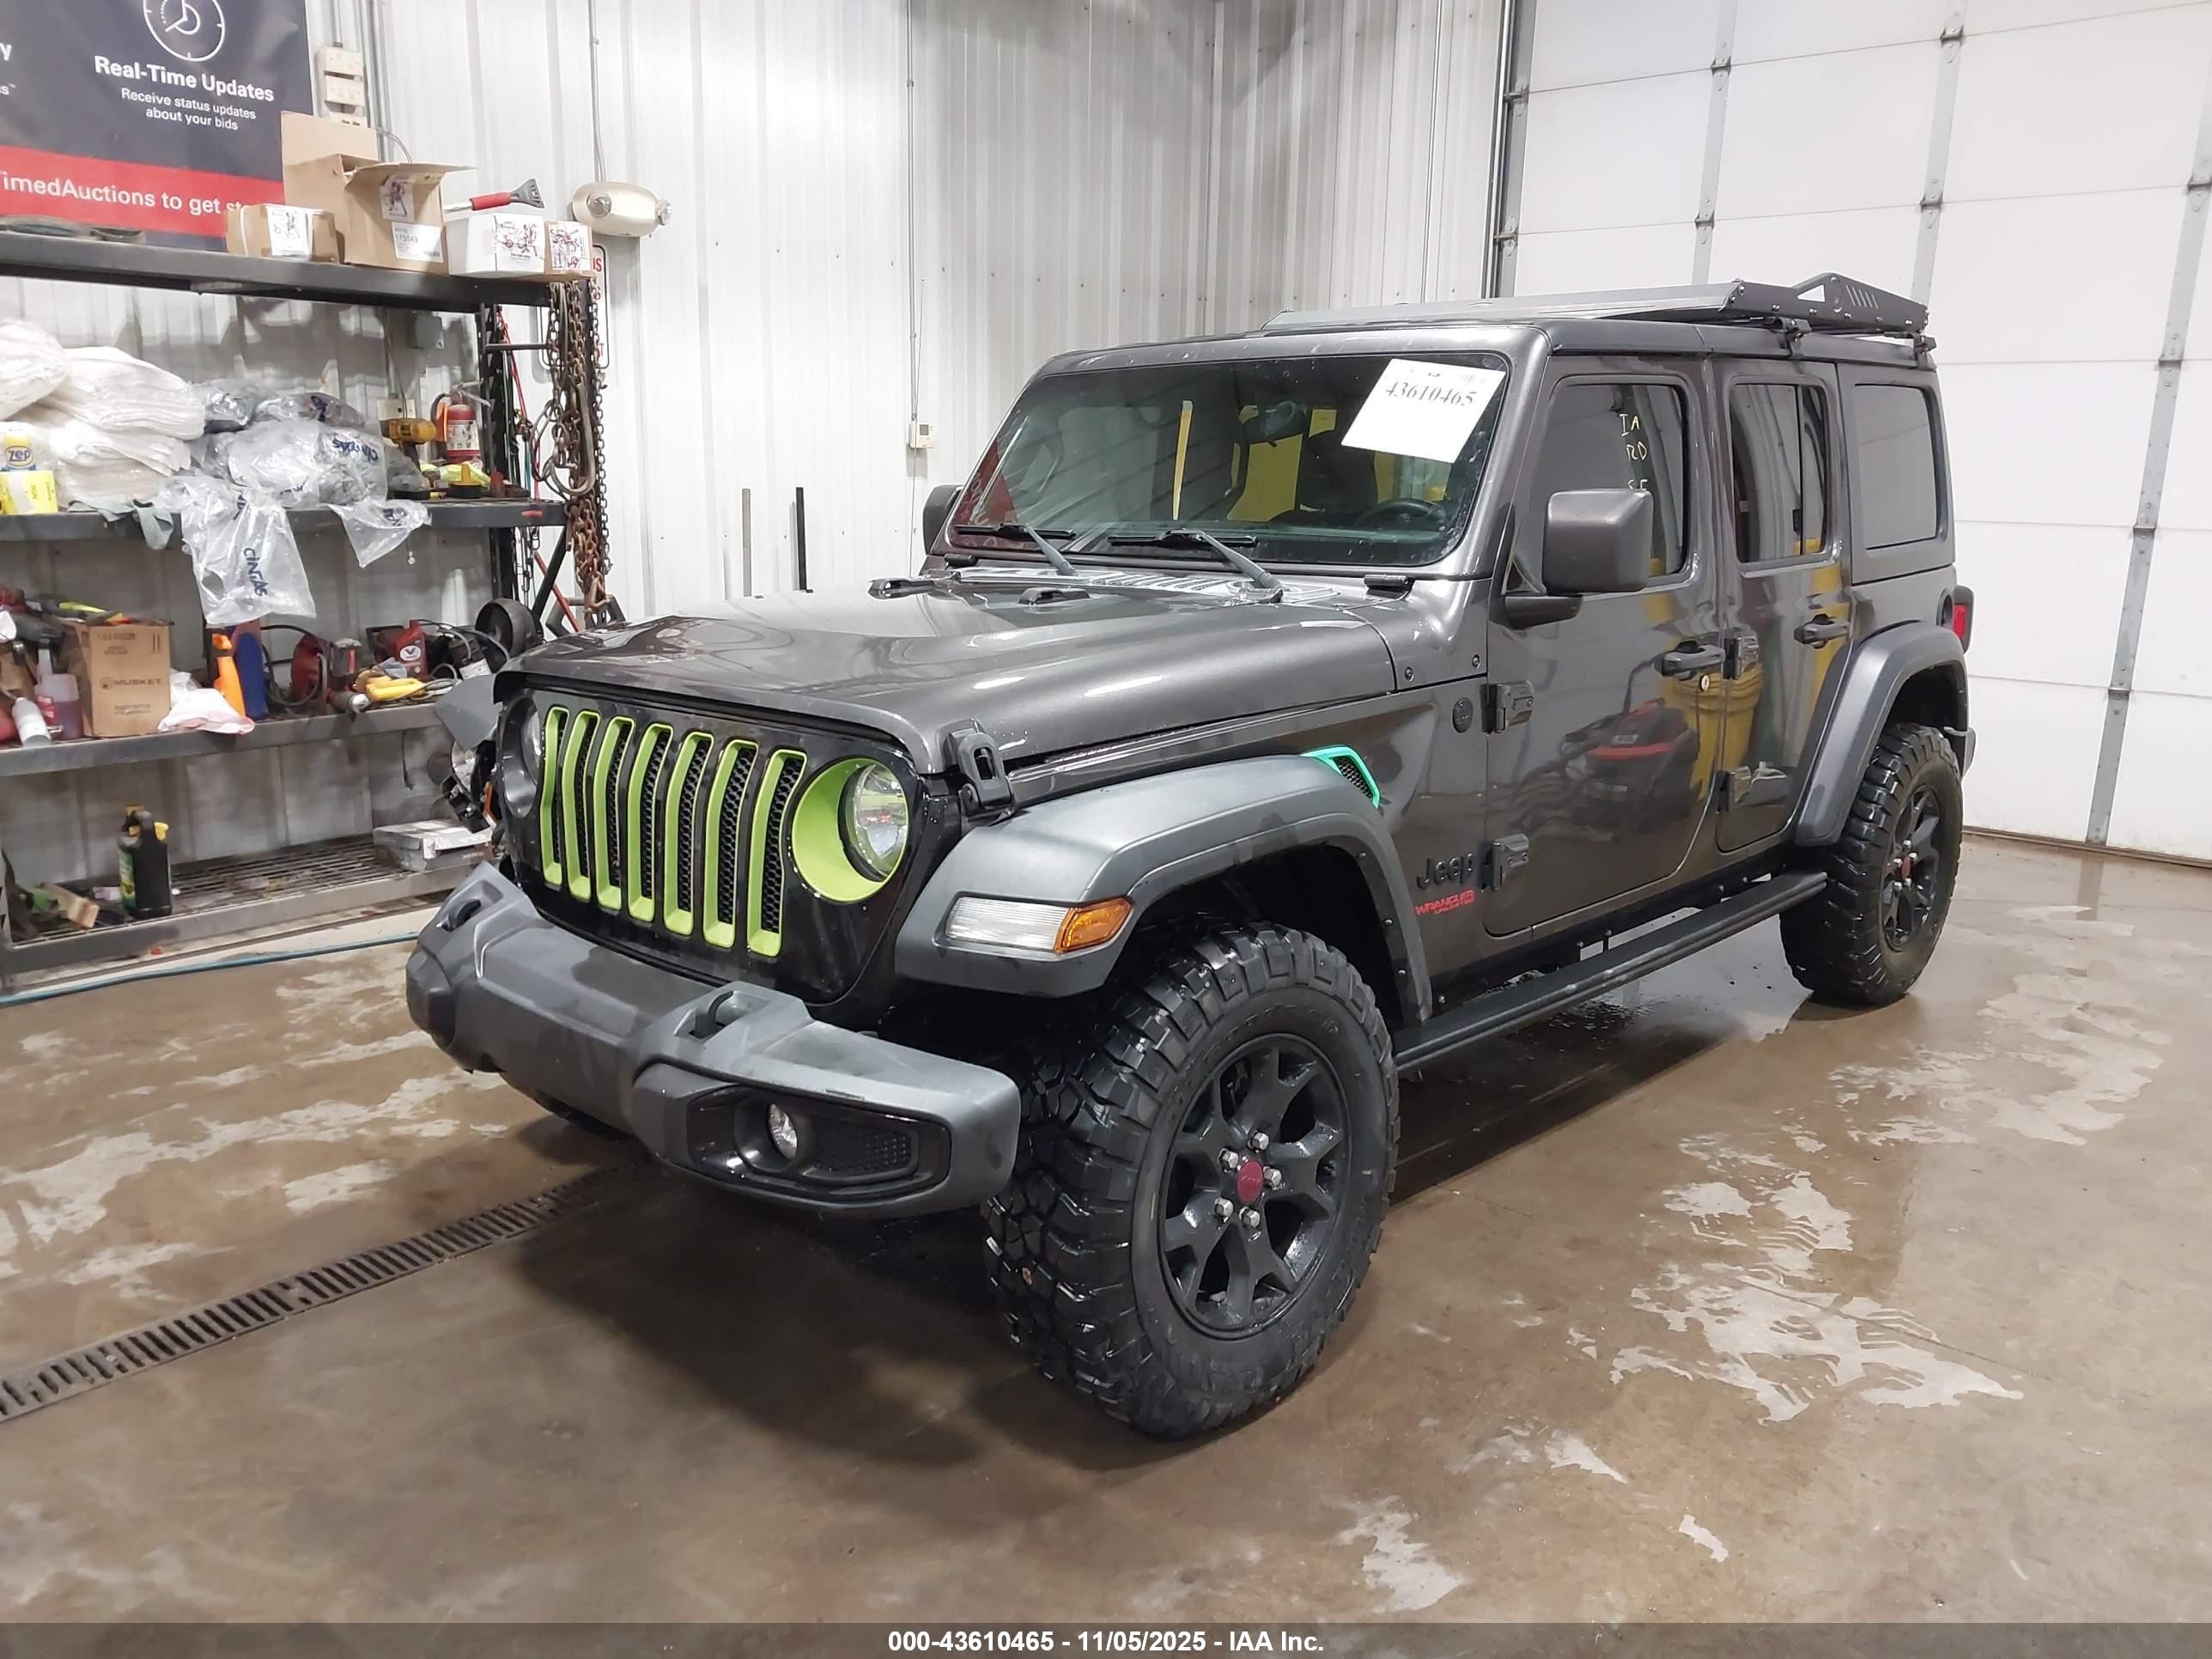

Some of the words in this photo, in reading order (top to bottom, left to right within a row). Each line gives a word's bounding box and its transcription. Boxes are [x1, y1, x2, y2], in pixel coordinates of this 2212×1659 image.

[94, 55, 198, 88] Real-Time
[201, 73, 275, 102] Updates
[121, 88, 172, 106] Receive
[173, 96, 210, 112] status
[212, 102, 256, 119] updates
[145, 106, 183, 122] about
[185, 112, 211, 126] your
[215, 116, 239, 131] bids
[0, 169, 155, 207] imedAuctions
[161, 191, 182, 210] to
[189, 197, 221, 216] get
[1385, 380, 1478, 407] 43610465
[243, 547, 268, 597] CINTAS
[1416, 853, 1474, 890] Jeep
